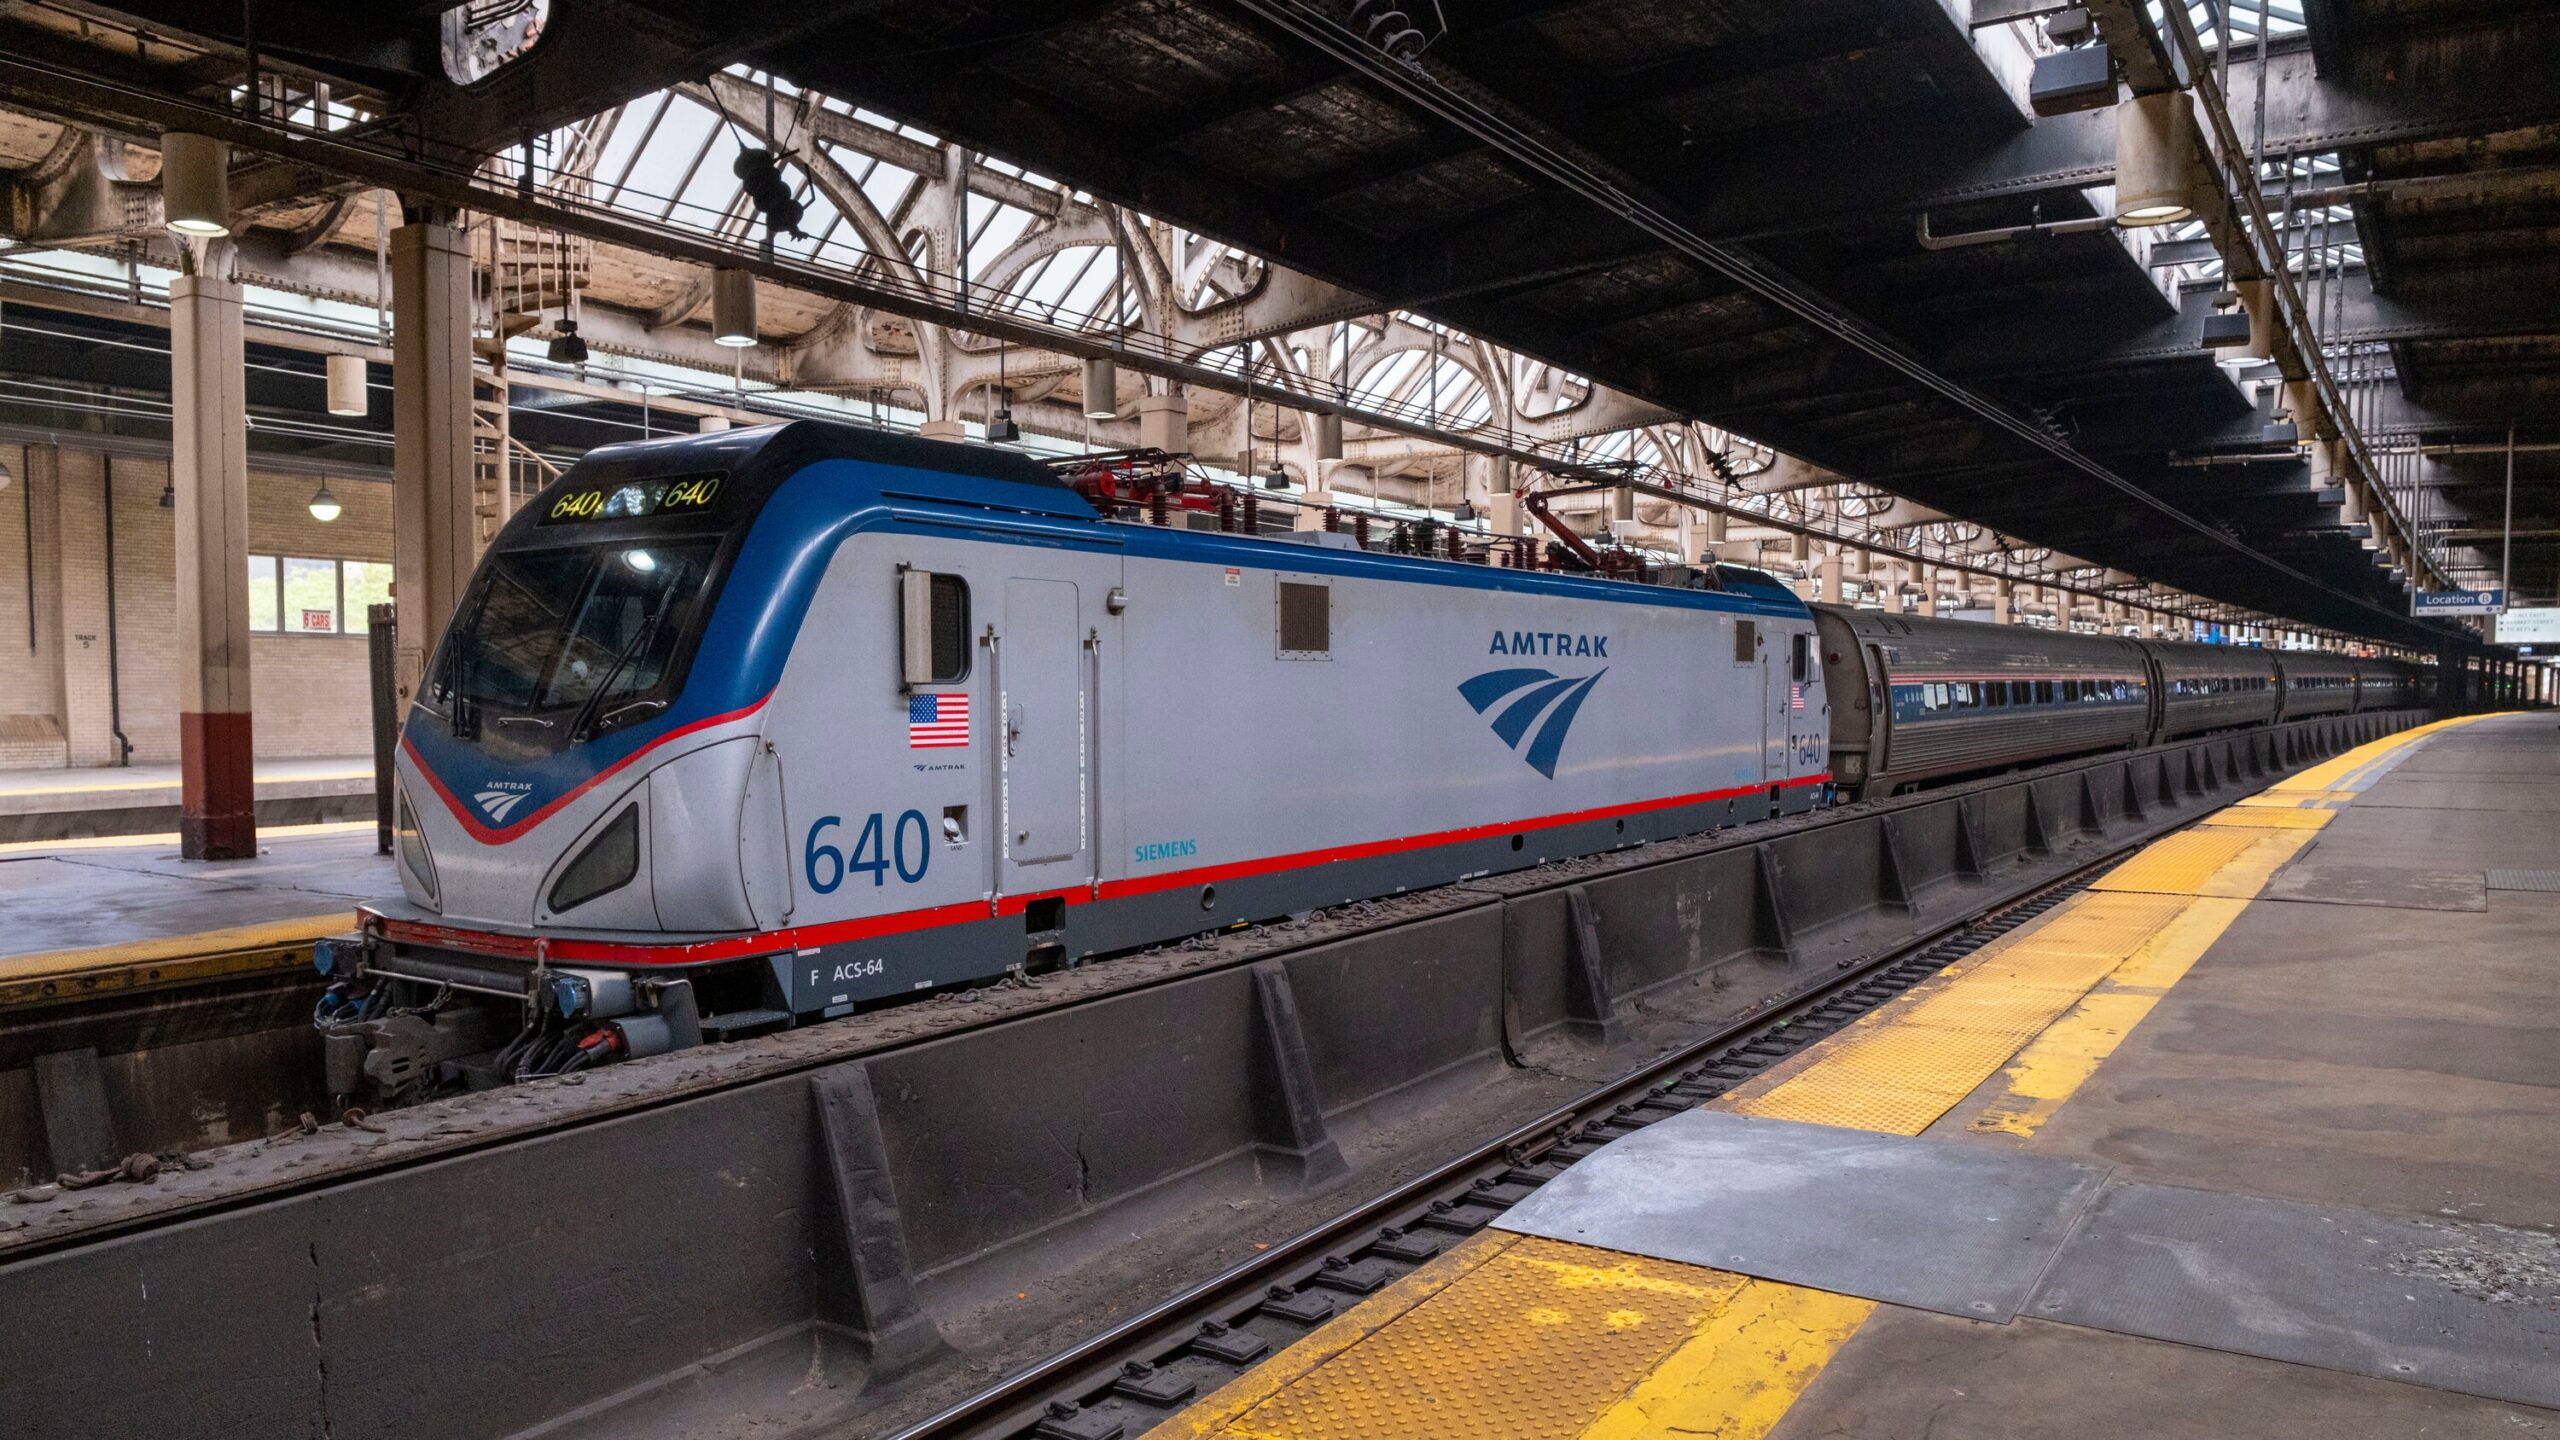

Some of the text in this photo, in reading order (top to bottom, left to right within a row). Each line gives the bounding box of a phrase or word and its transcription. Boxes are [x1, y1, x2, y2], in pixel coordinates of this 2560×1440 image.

[551, 491, 601, 518] 640
[665, 479, 720, 507] 640
[2426, 595, 2475, 605] Location
[303, 612, 330, 627] 6 CARS
[83, 641, 90, 649] 5
[1489, 630, 1609, 658] AMTRAK
[1800, 733, 1821, 766] 640
[486, 781, 533, 790] AMTRAK
[805, 809, 930, 895] 640
[1135, 838, 1197, 863] SIEMENS
[811, 958, 884, 986] F ACS-64
